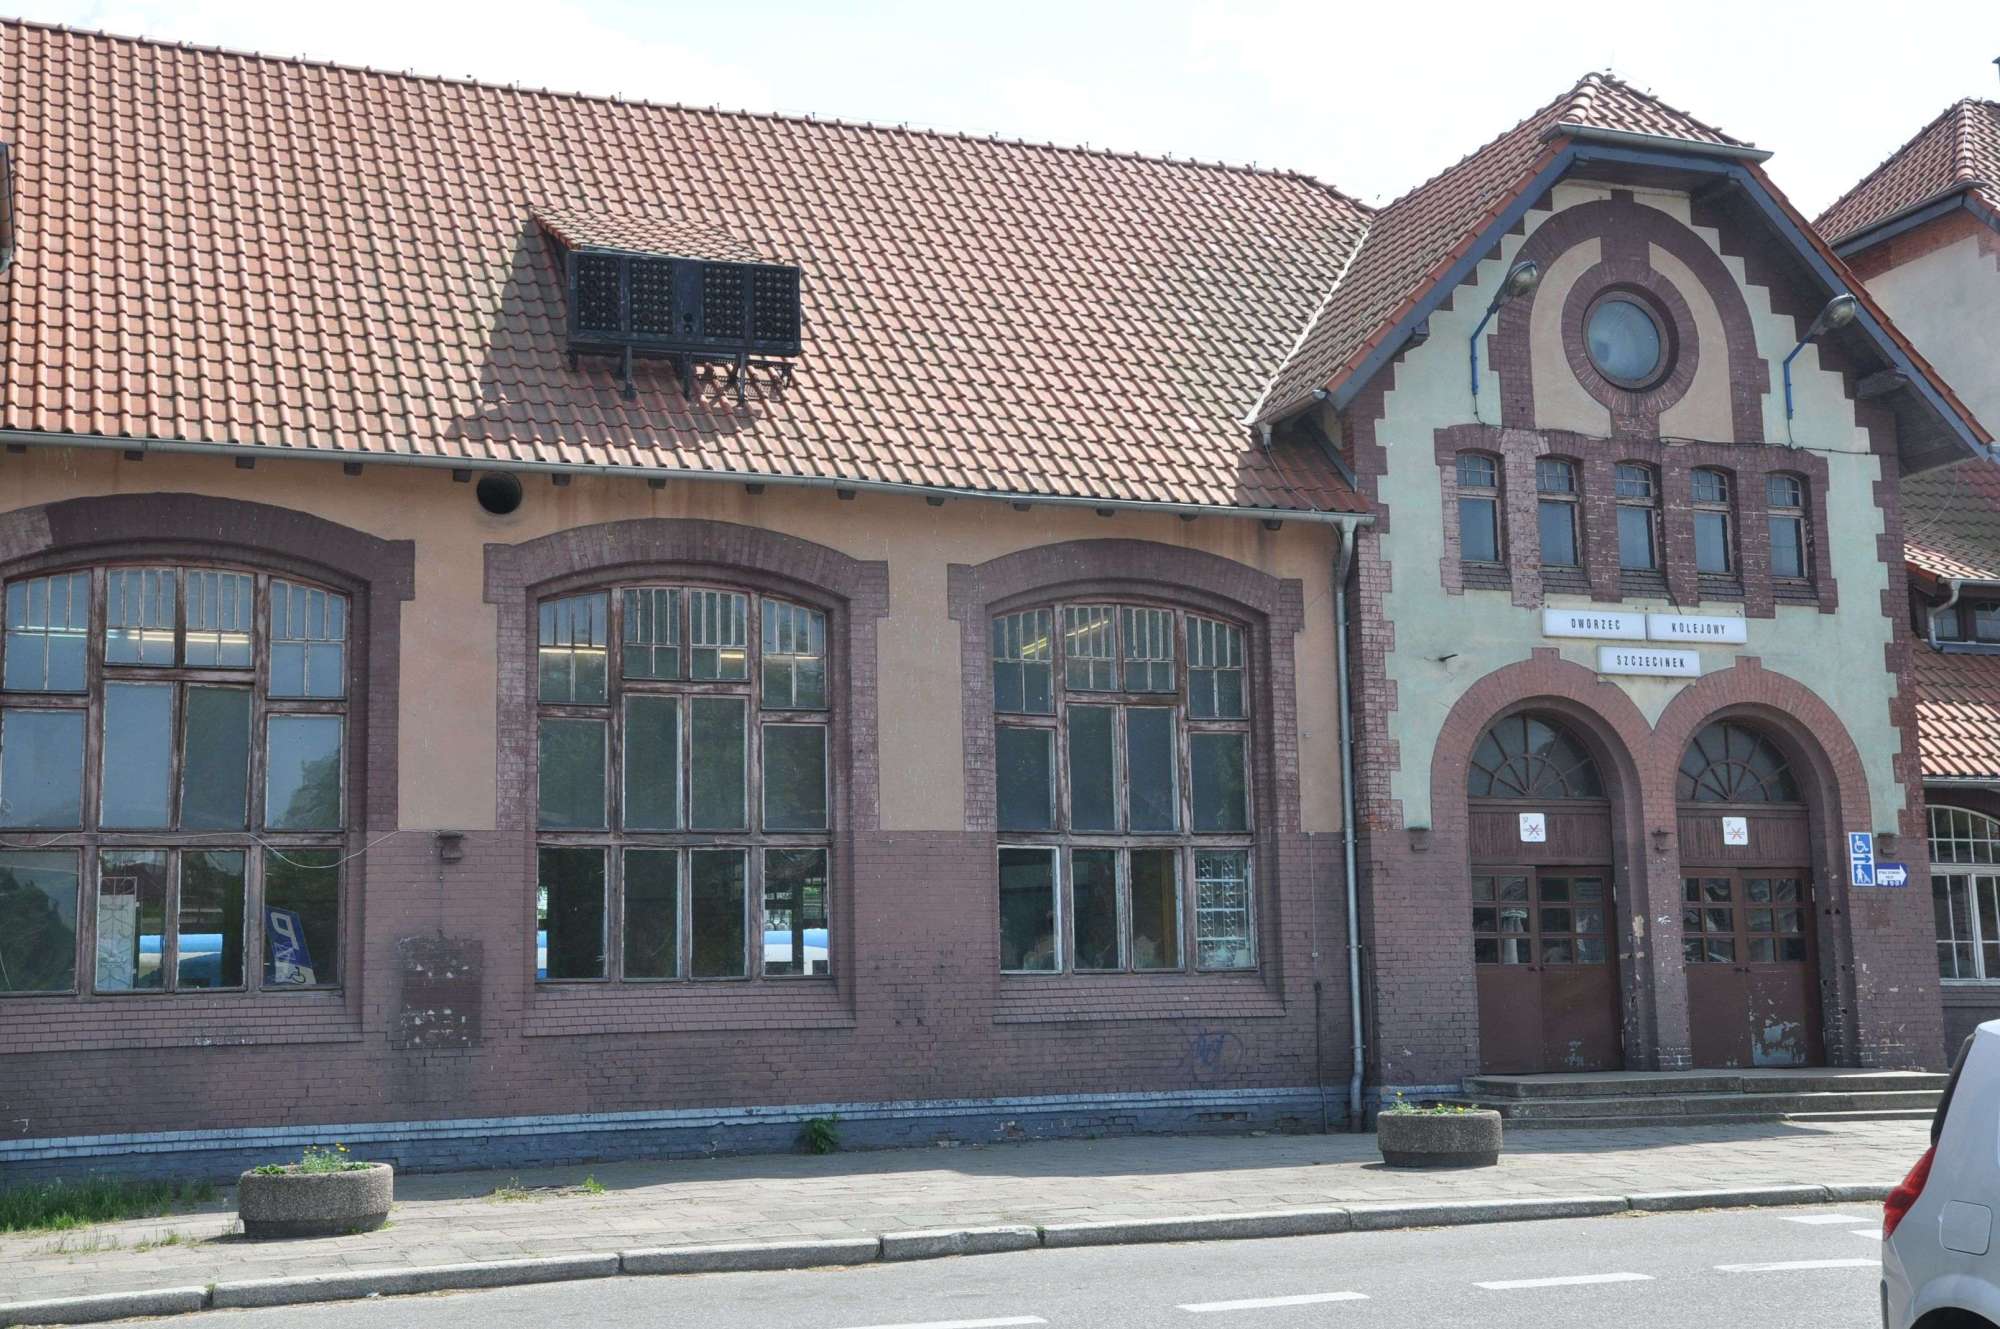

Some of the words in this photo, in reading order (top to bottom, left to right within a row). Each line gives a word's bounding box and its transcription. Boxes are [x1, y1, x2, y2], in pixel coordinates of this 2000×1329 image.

[1571, 618, 1620, 630] DWORZEC
[1671, 622, 1726, 635] KOLEJOWY
[1616, 655, 1686, 668] SZCZECINEK
